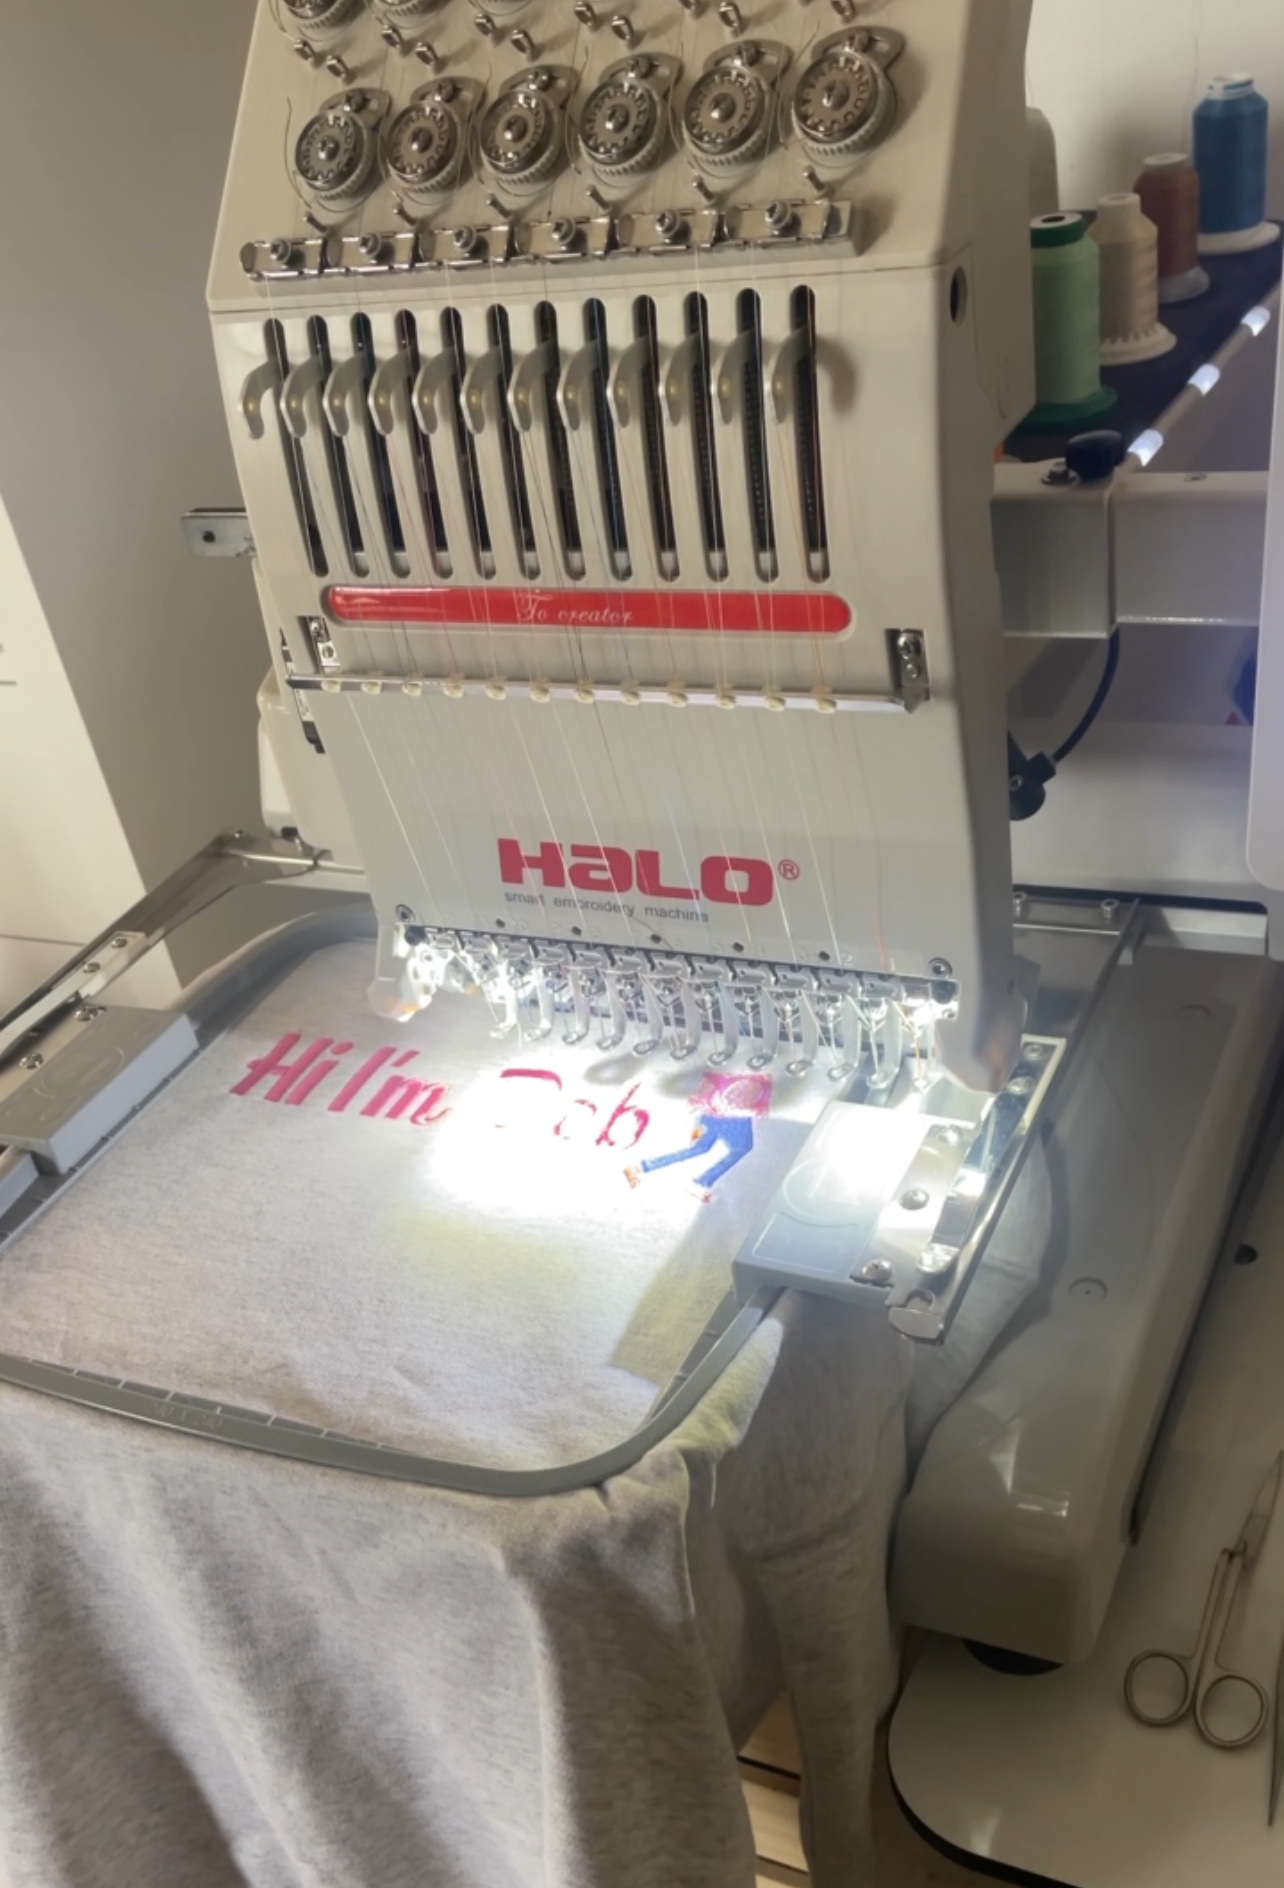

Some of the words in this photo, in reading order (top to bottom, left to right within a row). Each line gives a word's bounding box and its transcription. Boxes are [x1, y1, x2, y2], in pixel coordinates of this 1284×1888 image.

[518, 589, 554, 622] To
[557, 607, 634, 623] creator
[504, 892, 546, 907] smart
[644, 901, 709, 924] machine
[229, 1031, 354, 1105] Hi
[327, 1046, 452, 1125] I'm
